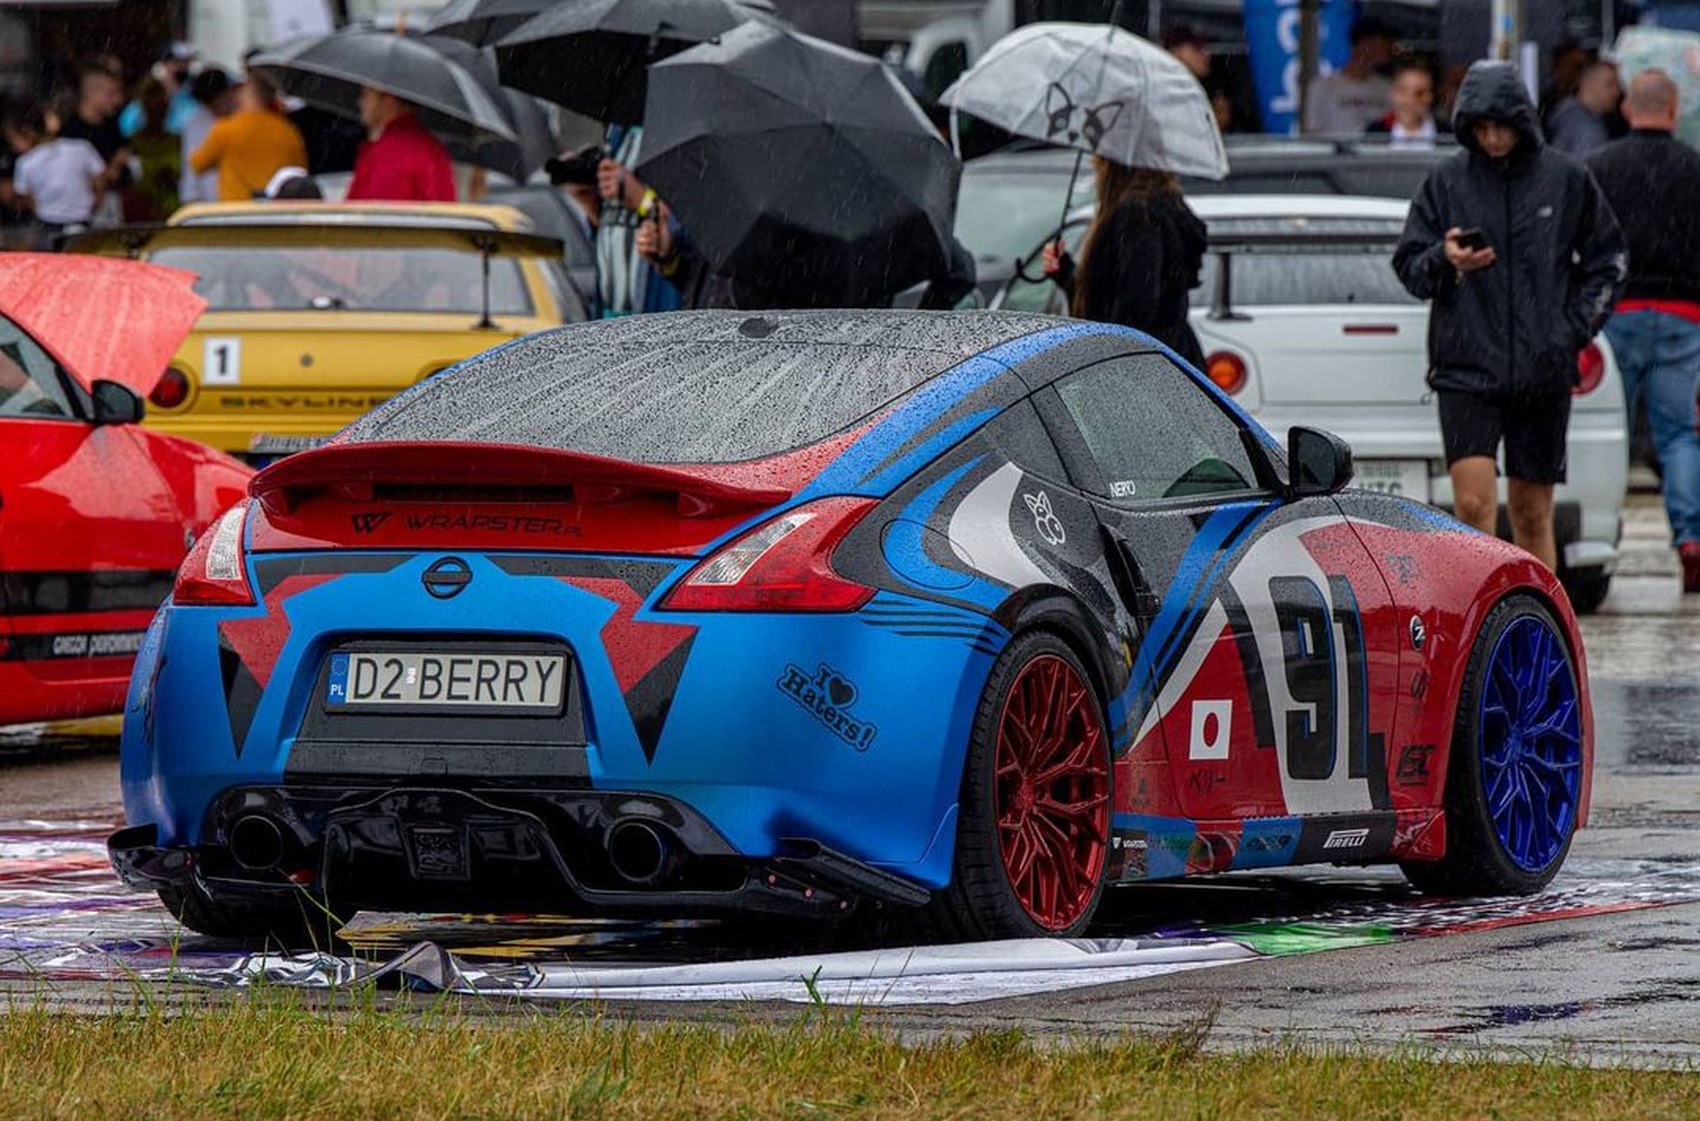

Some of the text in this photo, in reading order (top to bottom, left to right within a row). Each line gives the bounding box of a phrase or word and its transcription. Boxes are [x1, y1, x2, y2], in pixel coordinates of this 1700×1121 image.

[215, 346, 227, 376] 1
[330, 684, 344, 696] PL
[353, 658, 557, 702] D2 BERRY
[1269, 574, 1369, 780] 91
[781, 668, 874, 748] Haters!
[1322, 828, 1369, 849] PIRELLI
